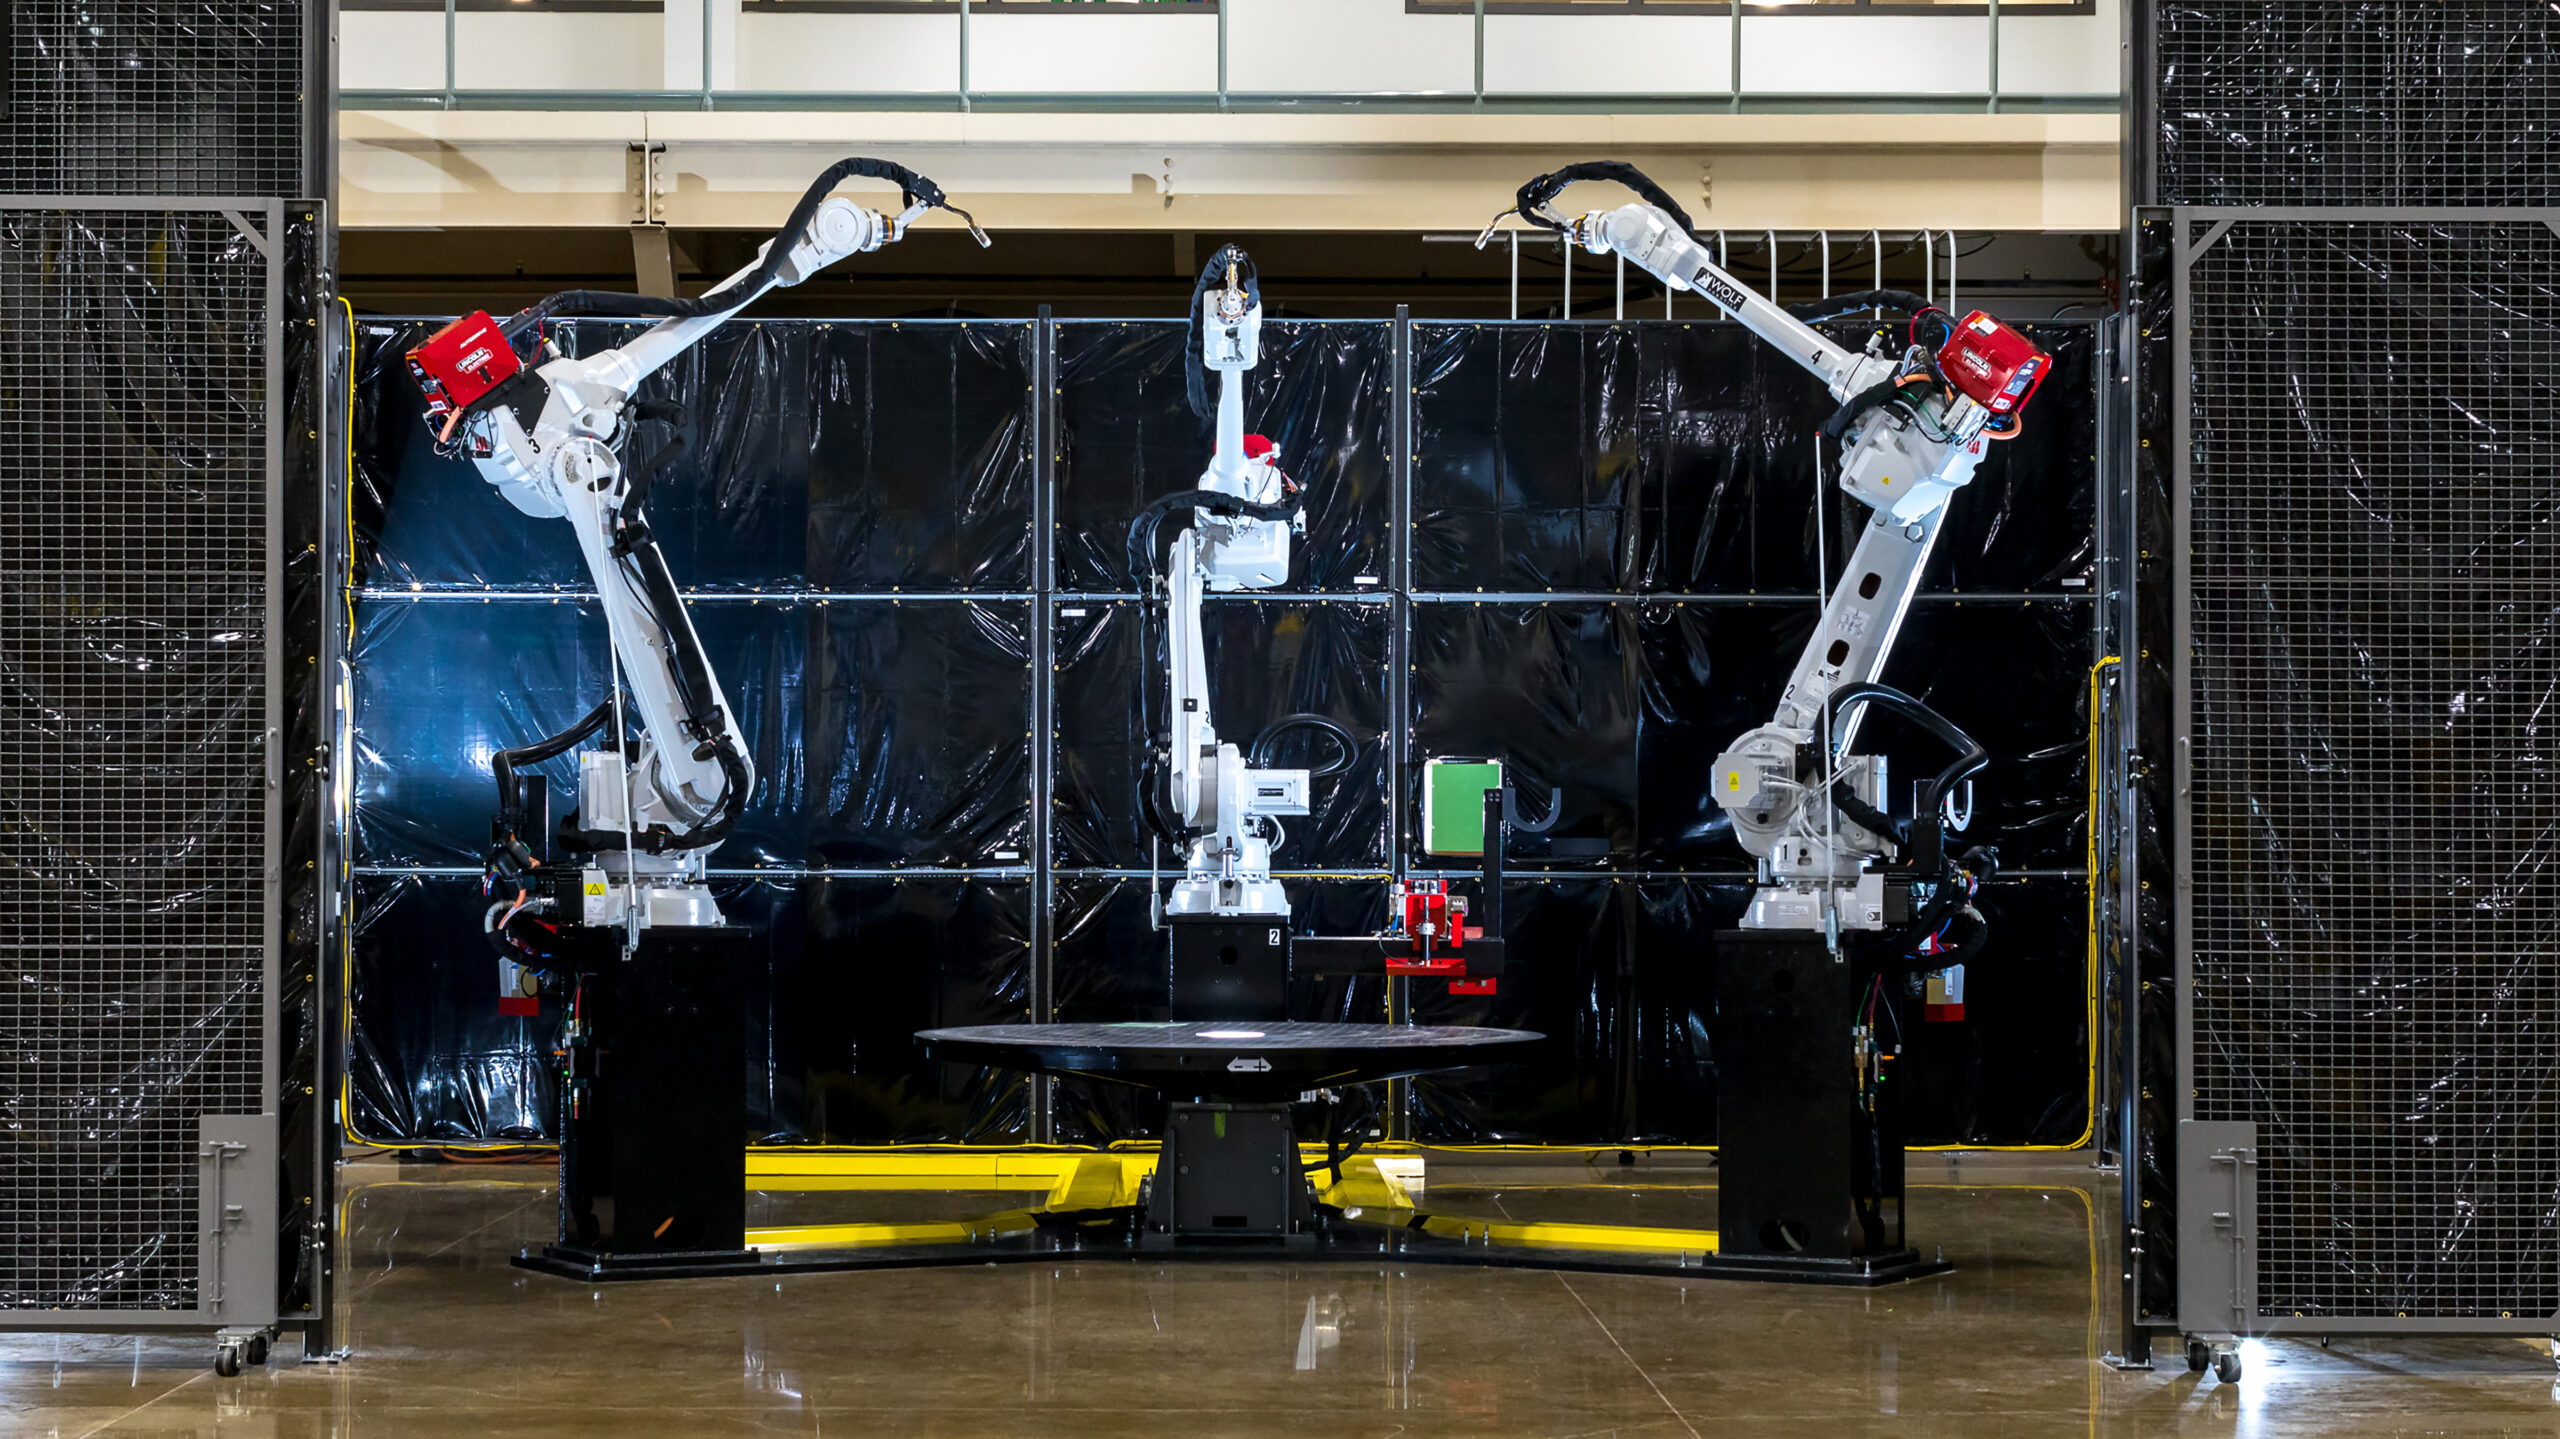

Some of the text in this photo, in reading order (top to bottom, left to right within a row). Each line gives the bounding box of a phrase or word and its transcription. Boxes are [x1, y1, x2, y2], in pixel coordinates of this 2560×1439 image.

[1711, 278, 1744, 305] WOLF
[458, 347, 485, 370] LINCOLN
[1811, 350, 1824, 365] 4
[1963, 348, 1990, 370] LINCOLN
[528, 438, 541, 454] 3
[1785, 684, 1796, 700] 2
[1783, 844, 1788, 860] 1
[1270, 930, 1279, 944] 2
